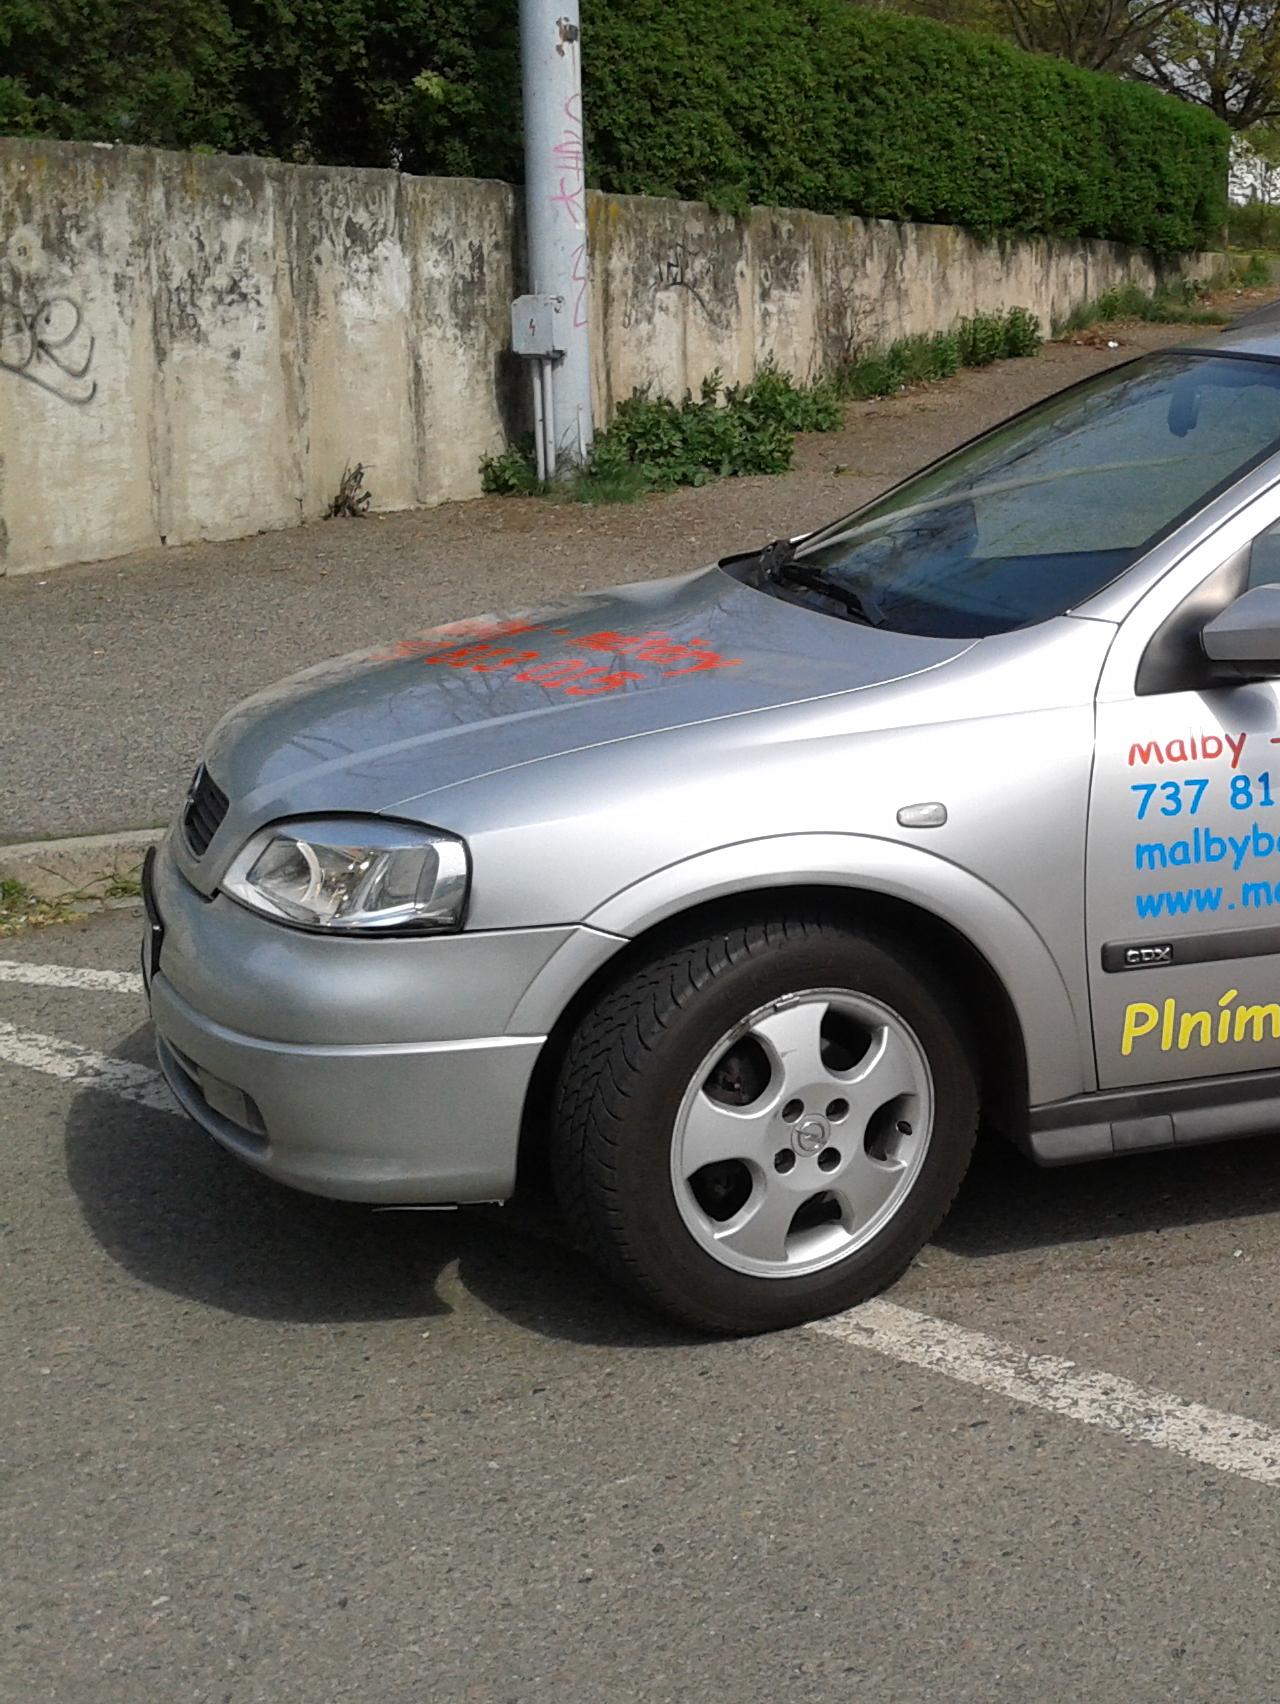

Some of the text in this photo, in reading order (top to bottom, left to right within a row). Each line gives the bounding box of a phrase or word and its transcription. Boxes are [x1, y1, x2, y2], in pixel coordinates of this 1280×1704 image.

[513, 658, 646, 696] 015
[1131, 779, 1209, 819] 737
[1126, 947, 1171, 963] CDX
